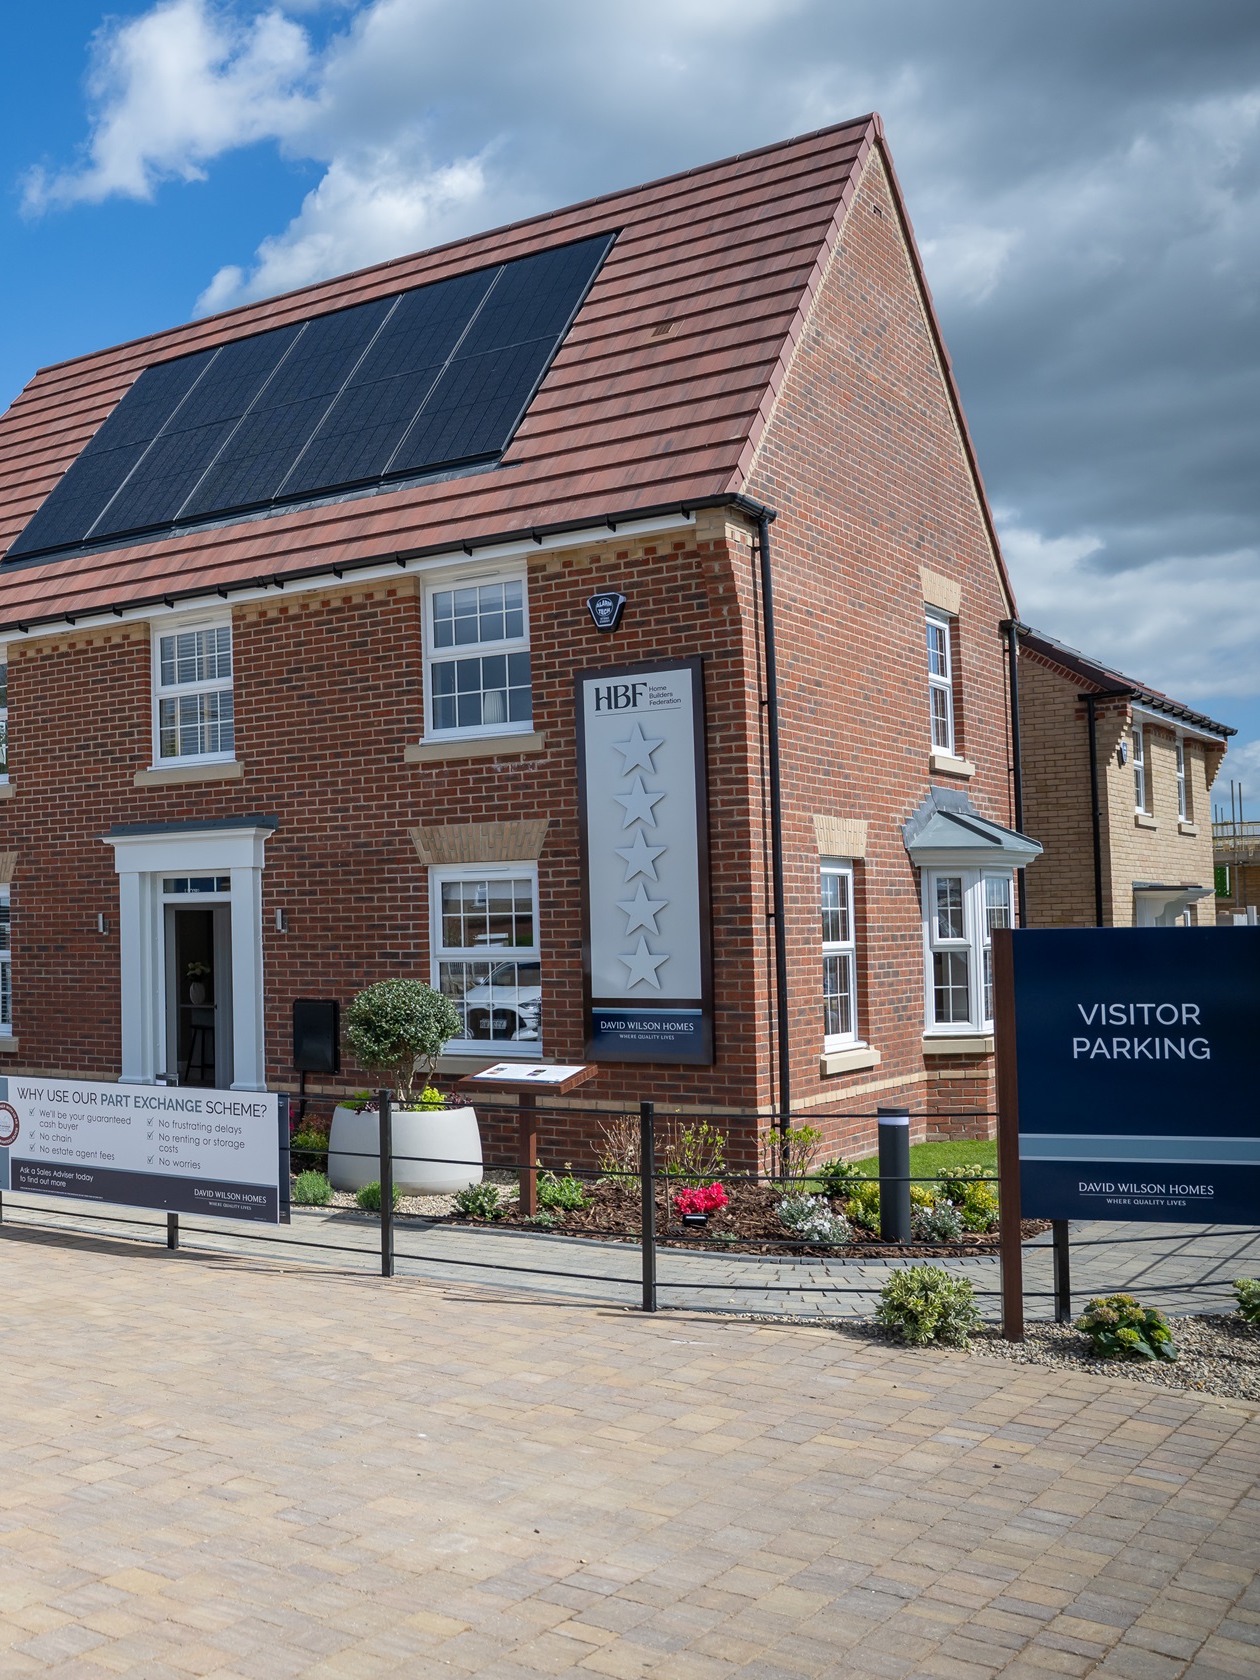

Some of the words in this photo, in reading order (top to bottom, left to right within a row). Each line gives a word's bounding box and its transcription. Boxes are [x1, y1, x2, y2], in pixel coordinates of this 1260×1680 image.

[598, 608, 610, 616] TECH
[594, 682, 647, 711] HBF
[649, 691, 673, 699] Builders
[649, 698, 681, 706] Federation
[1078, 1003, 1201, 1026] VISITOR
[600, 1021, 626, 1029] DAVID
[627, 1021, 660, 1030] WILSON
[663, 1022, 694, 1031] HOMES
[1073, 1037, 1211, 1060] PARKING
[17, 1087, 44, 1100] WHY
[47, 1089, 69, 1103] USE
[72, 1091, 97, 1105] OUR
[101, 1093, 130, 1108] PART
[134, 1095, 202, 1113] EXCHANGE
[206, 1101, 267, 1118] SCHEME?
[39, 1109, 55, 1118] We'll
[58, 1111, 67, 1120] be
[69, 1113, 85, 1121] your
[87, 1115, 131, 1125] guaranteed
[40, 1120, 56, 1129] cash
[58, 1122, 78, 1131] buyer
[159, 1119, 170, 1128] No
[172, 1120, 212, 1134] frustrating
[215, 1124, 242, 1135] delays
[40, 1132, 49, 1141] No
[52, 1133, 72, 1143] chain
[159, 1133, 170, 1142] No
[172, 1134, 200, 1146] renting
[213, 1138, 245, 1150] storage
[40, 1145, 49, 1154] No
[52, 1147, 74, 1156] estate
[76, 1149, 97, 1159] agent
[99, 1151, 115, 1161] fees
[159, 1144, 179, 1154] costs
[159, 1158, 170, 1167] No
[173, 1160, 201, 1169] worries
[20, 1166, 30, 1174] Ask
[36, 1168, 51, 1177] Sales
[52, 1170, 74, 1179] Adviser
[76, 1172, 94, 1183] today
[27, 1175, 38, 1184] find
[40, 1177, 49, 1185] out
[1079, 1182, 1115, 1193] DAVID
[1117, 1183, 1166, 1194] WILSON
[1169, 1184, 1214, 1195] HOMES
[194, 1188, 213, 1198] DAVID
[215, 1190, 240, 1200] WILSON
[242, 1194, 266, 1204] HOMES
